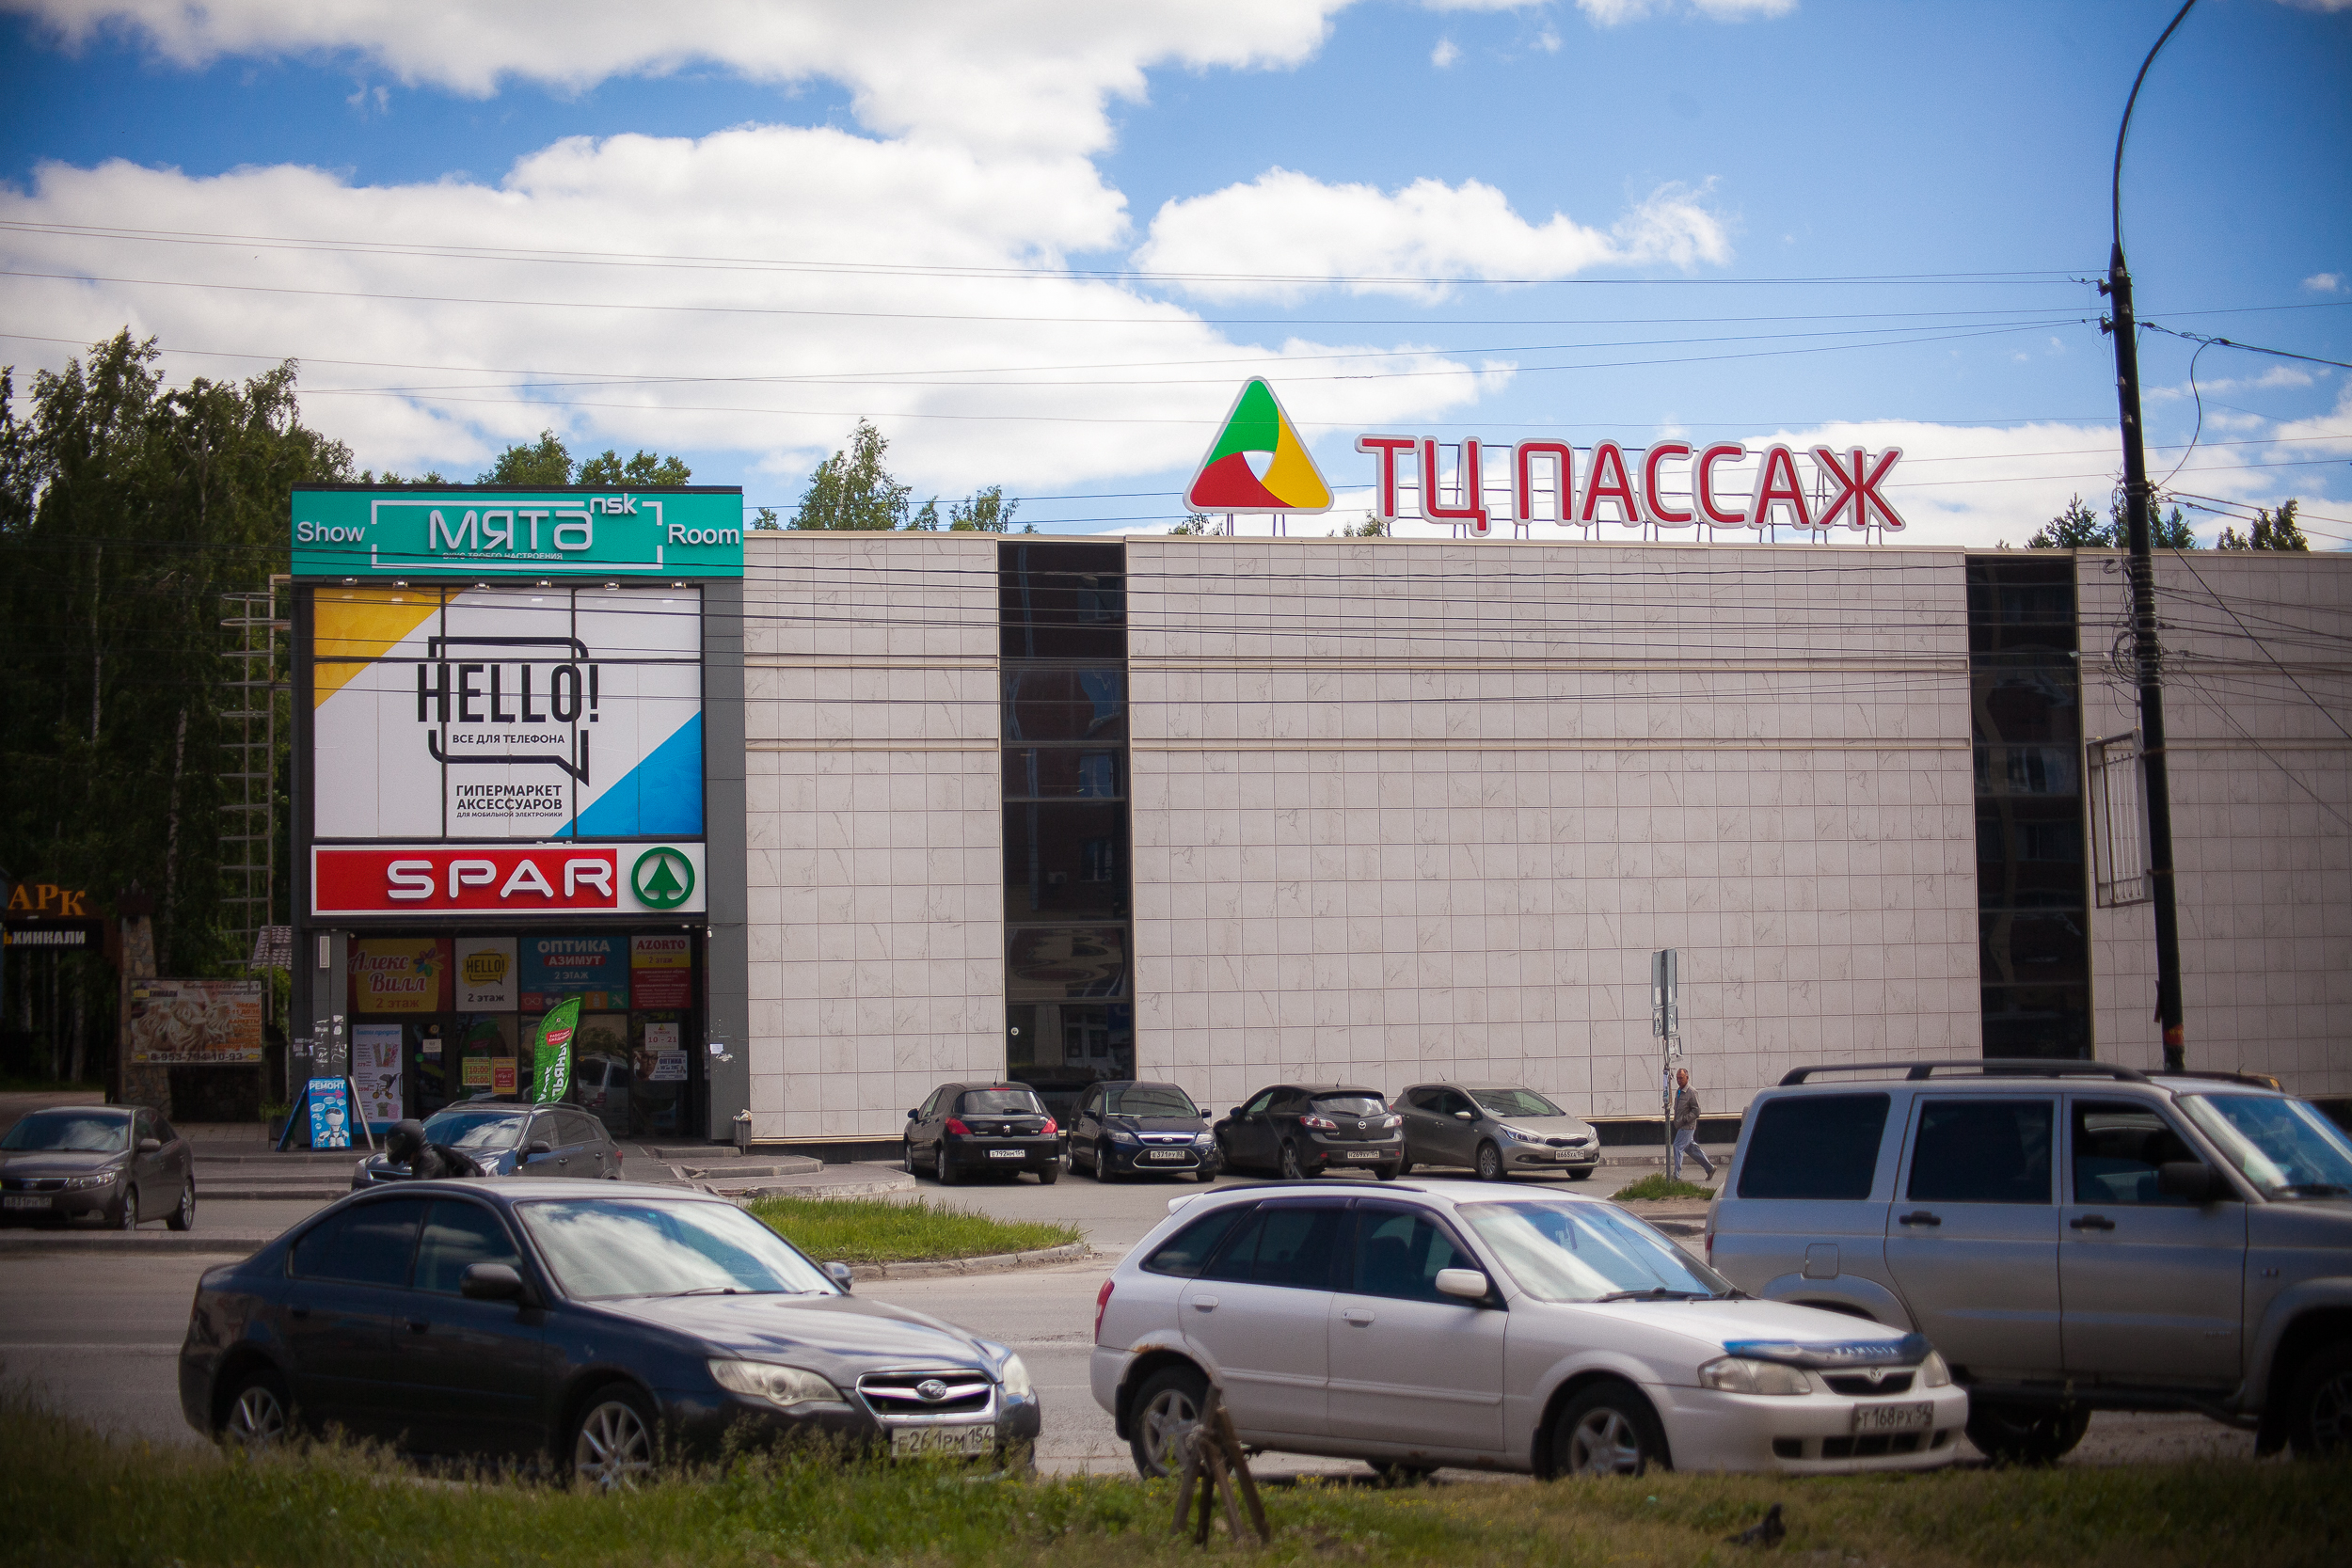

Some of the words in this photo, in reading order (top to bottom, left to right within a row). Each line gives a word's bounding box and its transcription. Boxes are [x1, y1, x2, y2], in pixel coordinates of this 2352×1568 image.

[1355, 434, 1491, 536] ТЦ
[1510, 437, 1906, 531] ПАССАЖ
[589, 493, 638, 515] nsk
[296, 521, 366, 542] Show
[668, 523, 739, 545] Room
[504, 552, 564, 561] НАСТРОЕНИЯ
[417, 663, 599, 723] HELLO!
[453, 735, 474, 744] ВСЕ
[476, 735, 501, 744] ДЛЯ
[502, 734, 565, 744] ТЕЛЕФОНА
[456, 784, 563, 797] ГИПЕРМАРКЕТ
[456, 799, 563, 810] АКСЕССУАРОВ
[387, 858, 612, 899] SPAR
[12, 930, 87, 944] ХИНКАЛИ
[537, 940, 612, 954] ОПТИКА
[636, 940, 686, 950] AZORTO
[348, 951, 409, 973] Алекс
[466, 959, 505, 973] HELLO!
[548, 956, 602, 965] АЗИМУТ
[368, 972, 427, 993] Вилл
[376, 998, 383, 1008] 2
[388, 999, 420, 1008] этаж
[468, 993, 474, 1002] 2
[309, 1082, 345, 1090] РЕМОНТ
